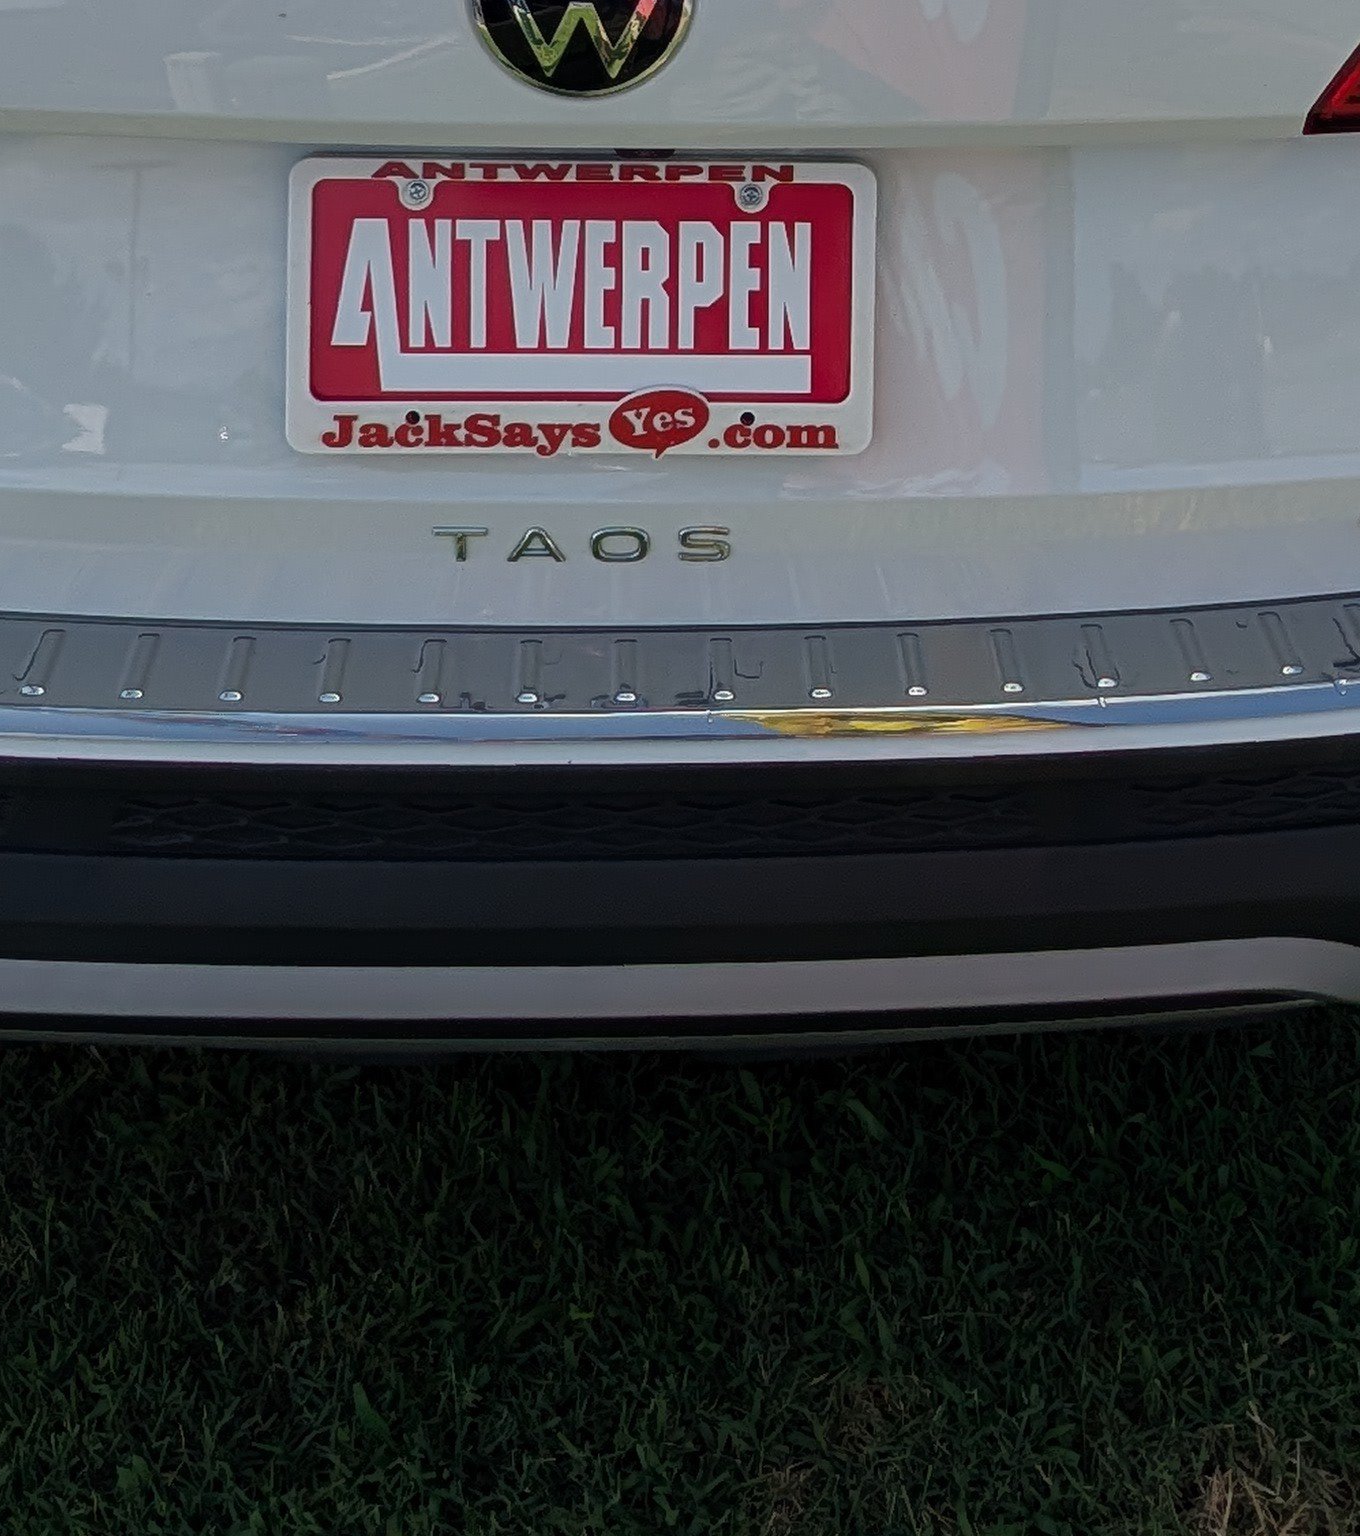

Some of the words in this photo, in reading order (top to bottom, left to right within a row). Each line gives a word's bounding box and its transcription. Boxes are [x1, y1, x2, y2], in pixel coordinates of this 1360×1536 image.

[371, 160, 795, 183] ANTWERPEN
[330, 217, 812, 352] ANTWERPEN
[321, 413, 602, 456] JackSays
[622, 405, 696, 435] Yes
[708, 419, 840, 449] .com
[432, 525, 731, 563] TAOS
